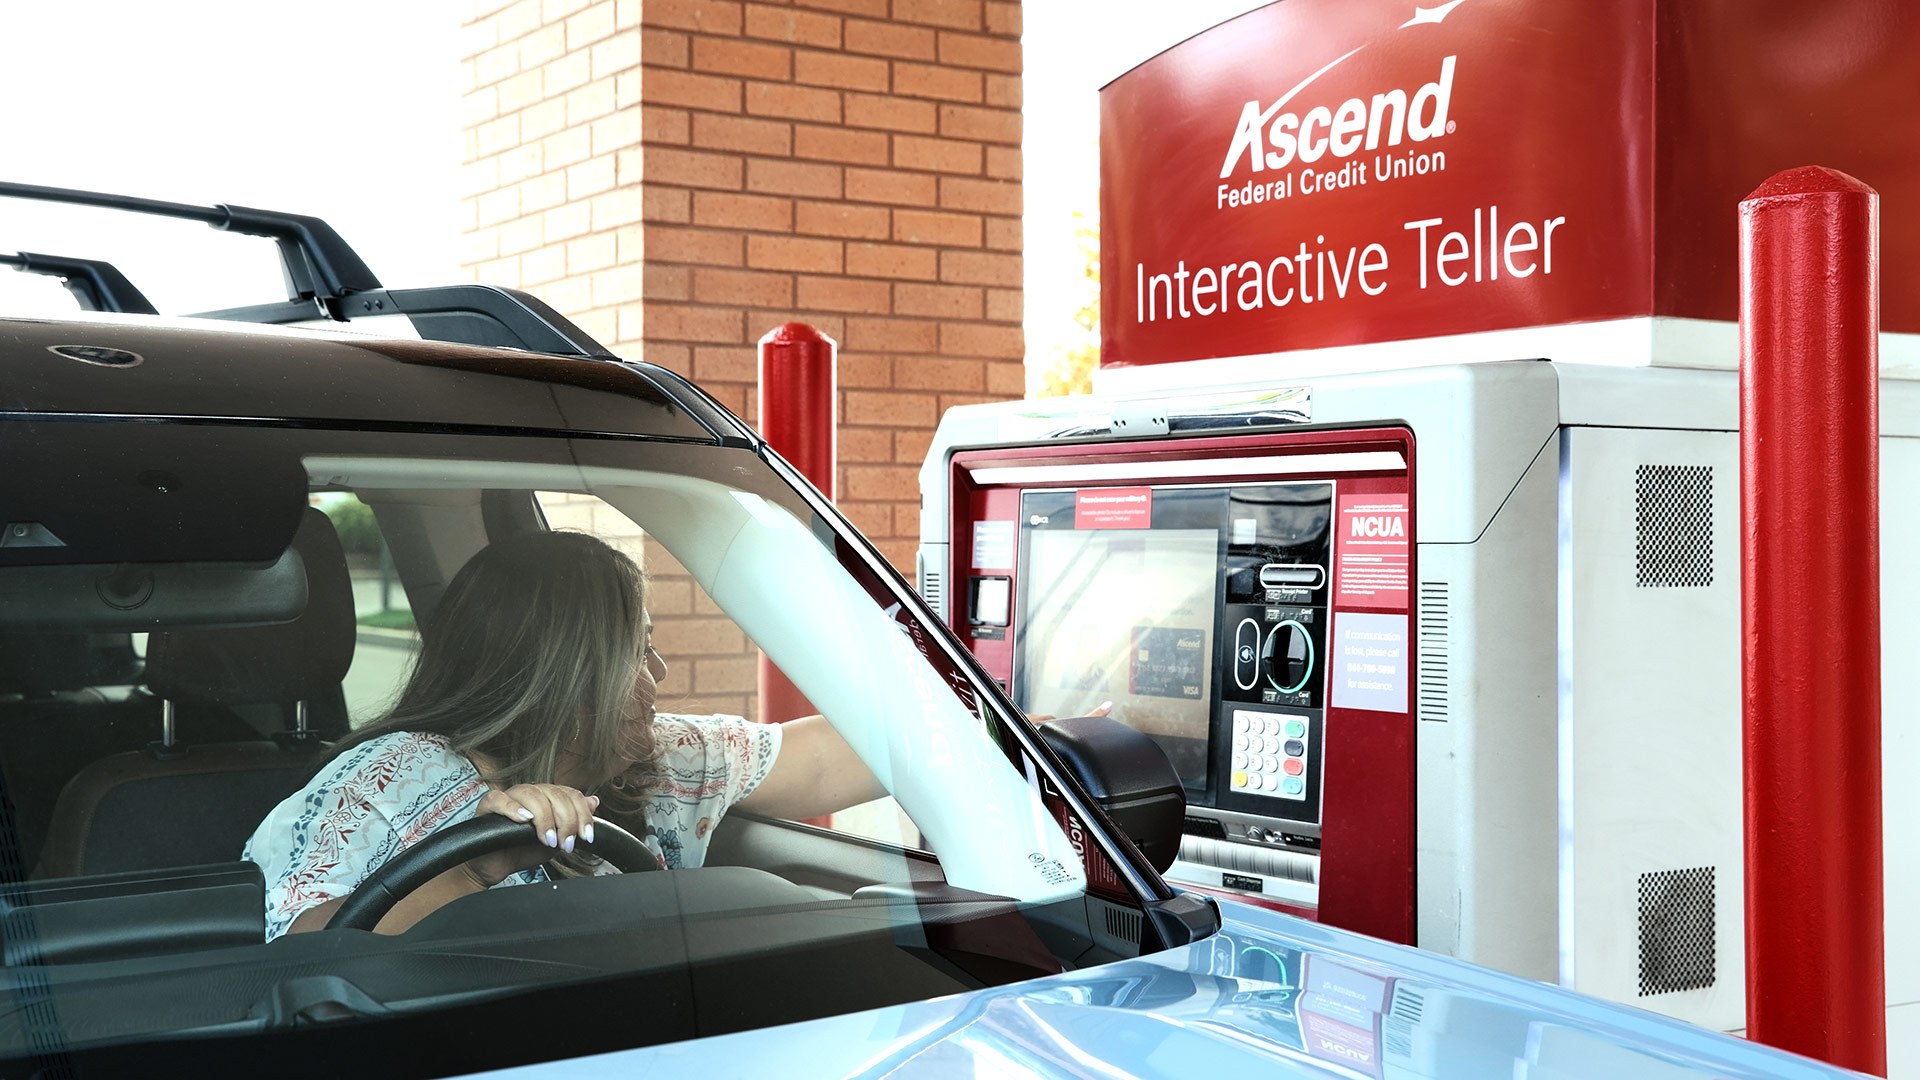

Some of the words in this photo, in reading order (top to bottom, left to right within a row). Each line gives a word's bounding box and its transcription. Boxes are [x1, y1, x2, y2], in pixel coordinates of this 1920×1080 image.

[1219, 55, 1456, 178] Ascend
[1217, 173, 1292, 209] Federal
[1299, 164, 1366, 194] Credit
[1375, 150, 1446, 181] Union
[1136, 234, 1389, 323] Interactive
[1404, 205, 1566, 290] Teller
[1351, 516, 1404, 537] NCUA
[1177, 638, 1200, 648] Ascend
[1351, 631, 1401, 641] communication
[1366, 647, 1387, 658] please
[1183, 686, 1199, 695] VISA
